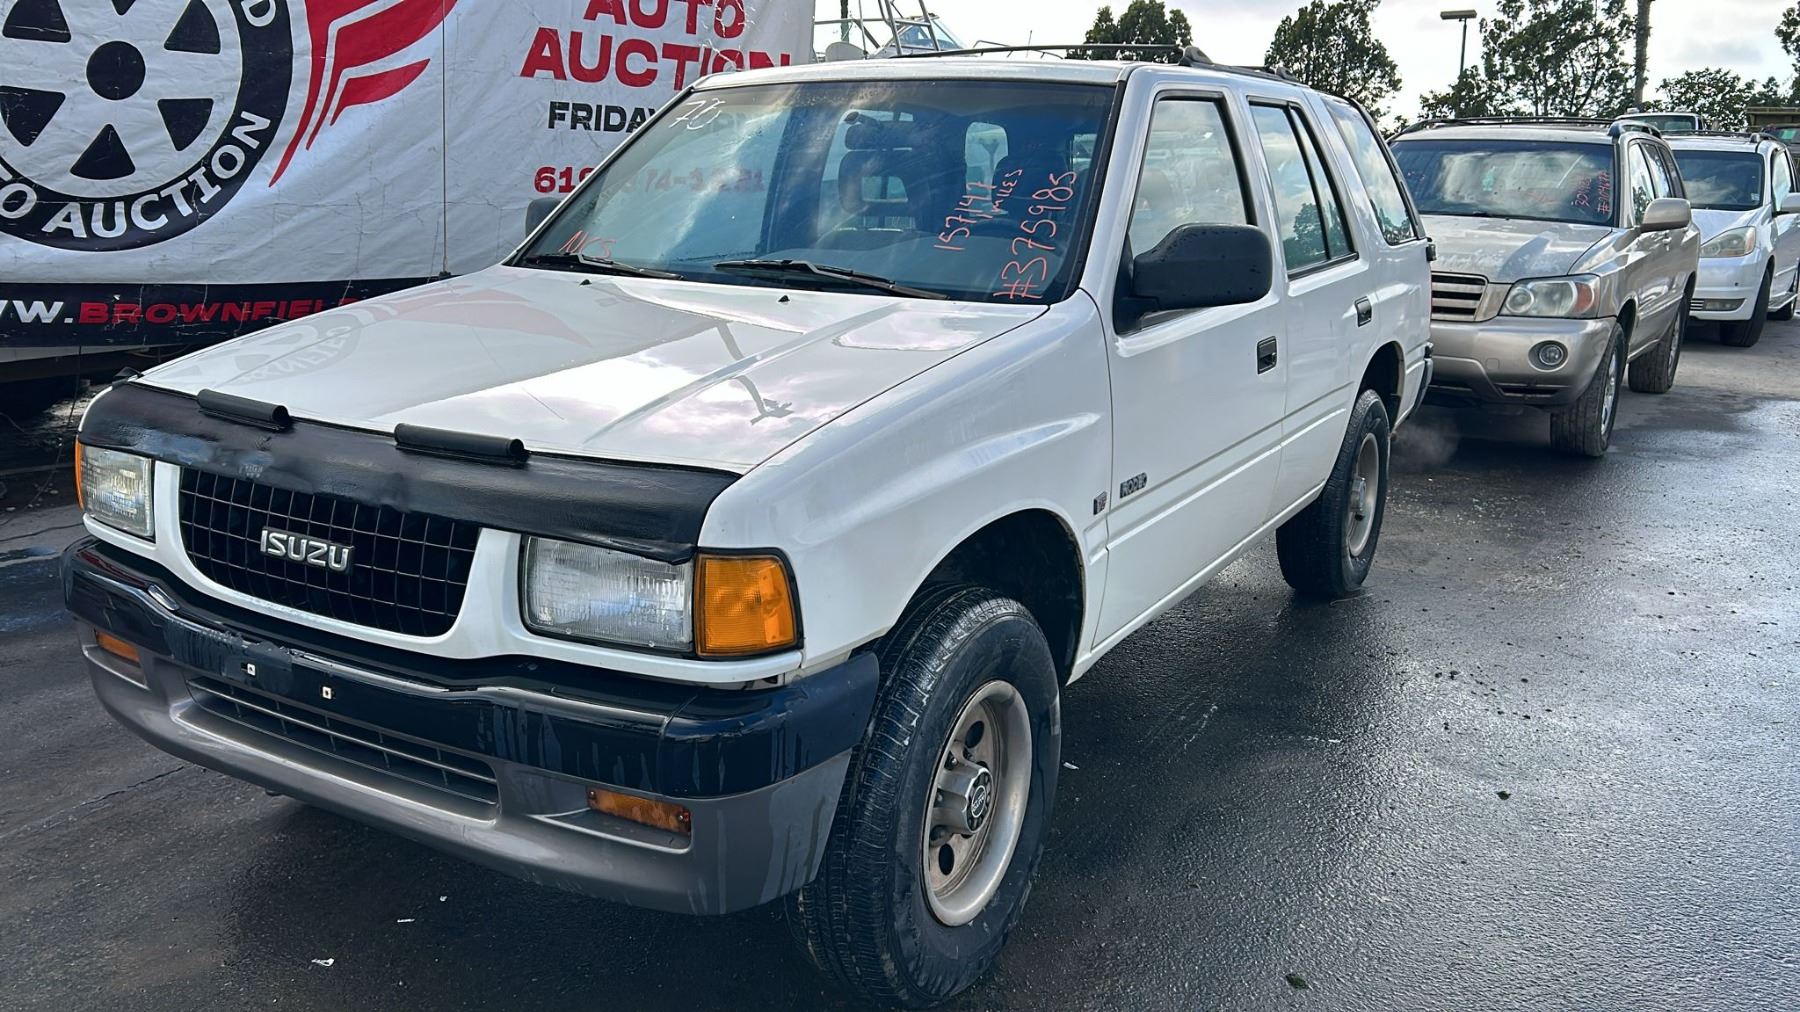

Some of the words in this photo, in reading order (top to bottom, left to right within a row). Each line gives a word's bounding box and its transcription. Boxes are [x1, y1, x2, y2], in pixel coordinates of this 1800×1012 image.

[547, 101, 656, 134] FRIDA
[42, 111, 271, 239] AUCTION
[993, 171, 1077, 299] #375985
[259, 529, 352, 572] ISUZU
